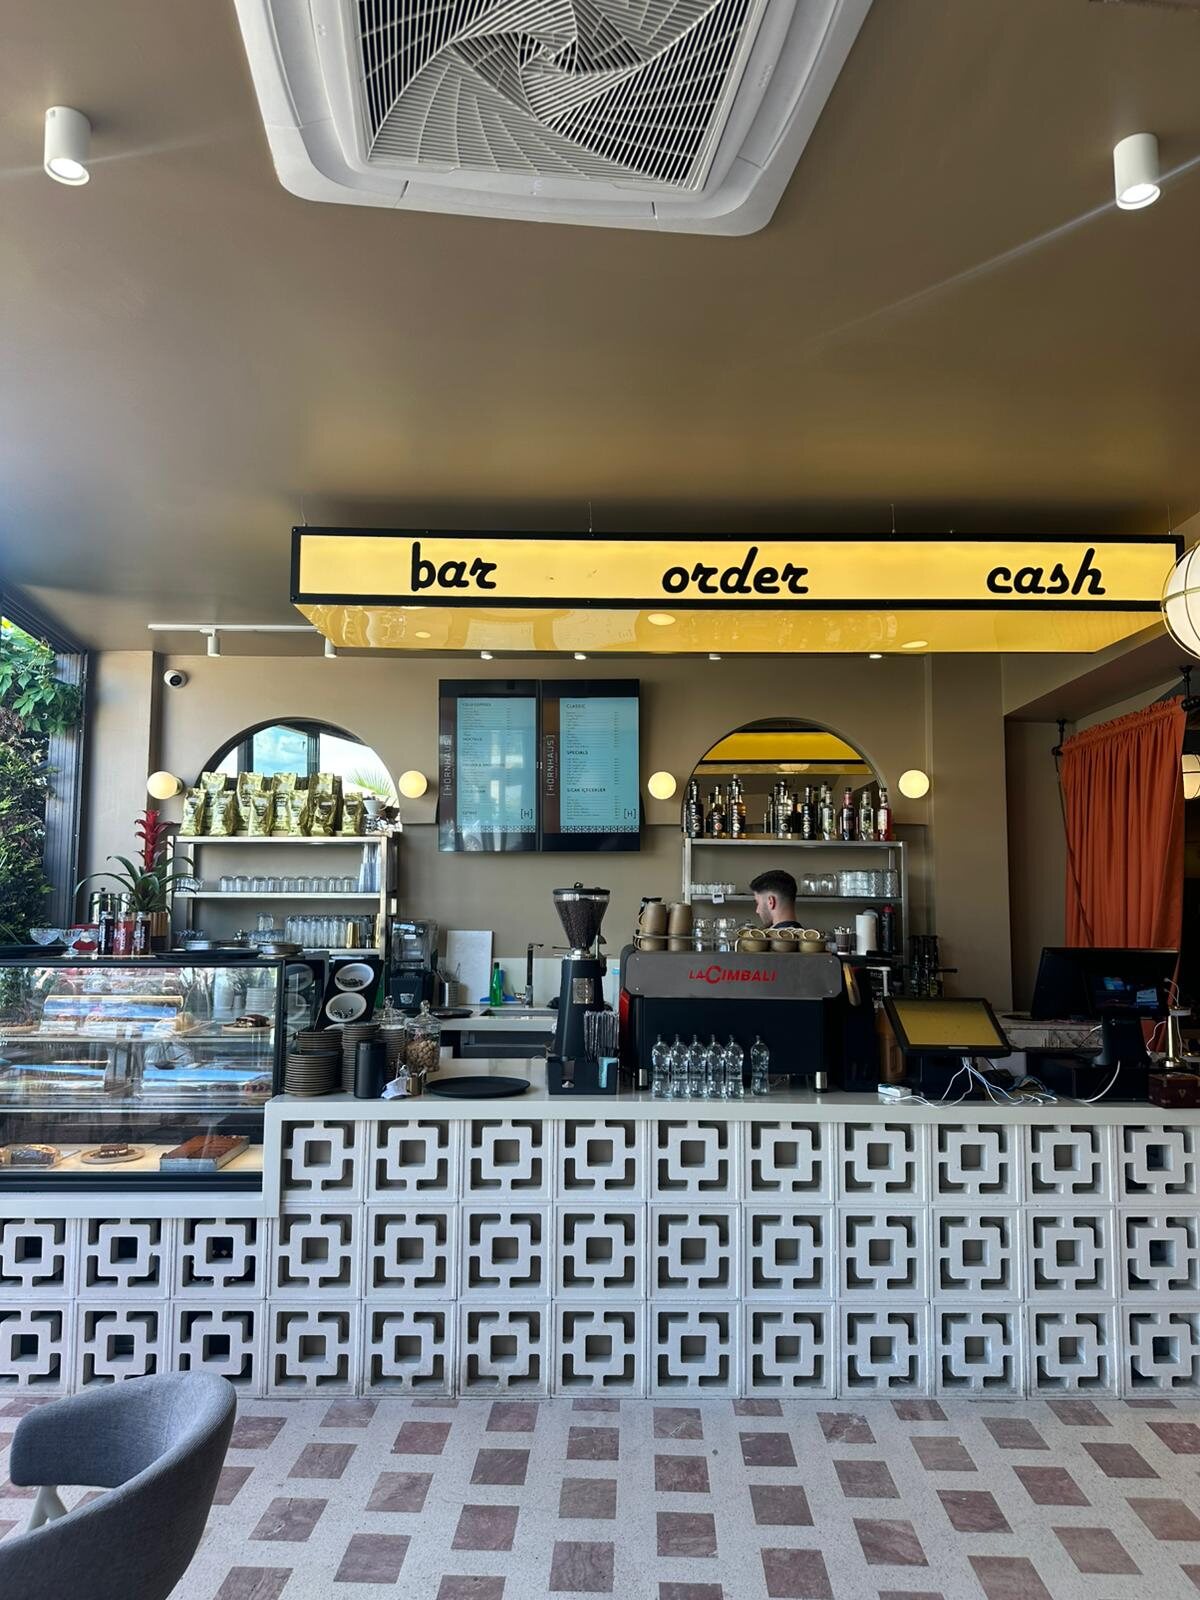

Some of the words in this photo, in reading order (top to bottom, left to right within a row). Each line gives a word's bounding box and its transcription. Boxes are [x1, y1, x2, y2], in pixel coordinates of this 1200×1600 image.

[411, 541, 497, 592] bar
[662, 546, 809, 594] order
[986, 547, 1106, 595] cash
